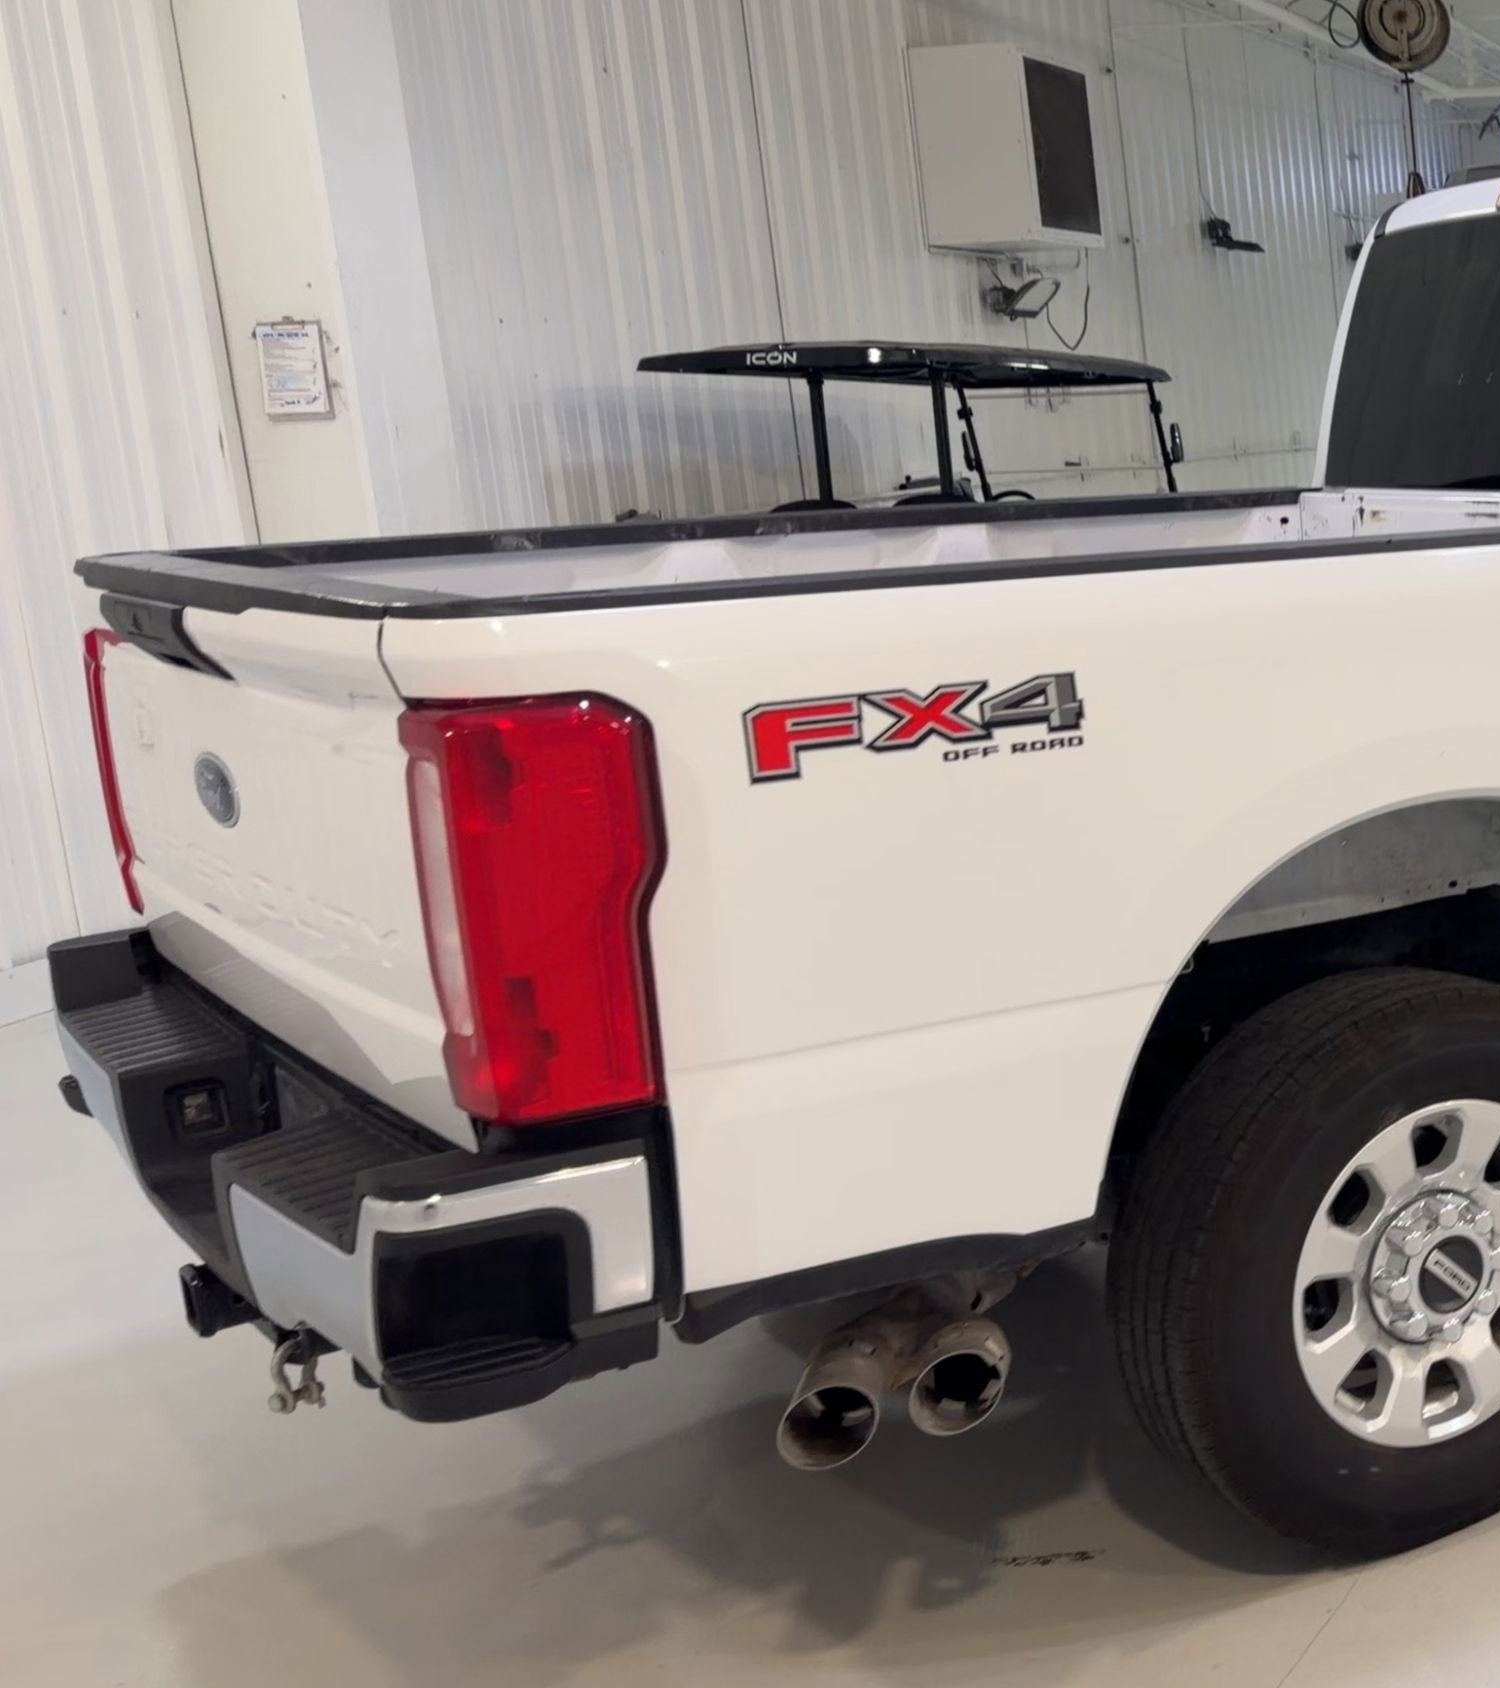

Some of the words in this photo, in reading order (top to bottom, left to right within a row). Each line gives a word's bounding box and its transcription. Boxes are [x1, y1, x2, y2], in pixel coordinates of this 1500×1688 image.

[745, 350, 797, 366] ICON
[742, 671, 1084, 785] FX4
[942, 738, 999, 763] OFF
[1011, 734, 1084, 756] ROAD
[1433, 1259, 1471, 1291] FORD
